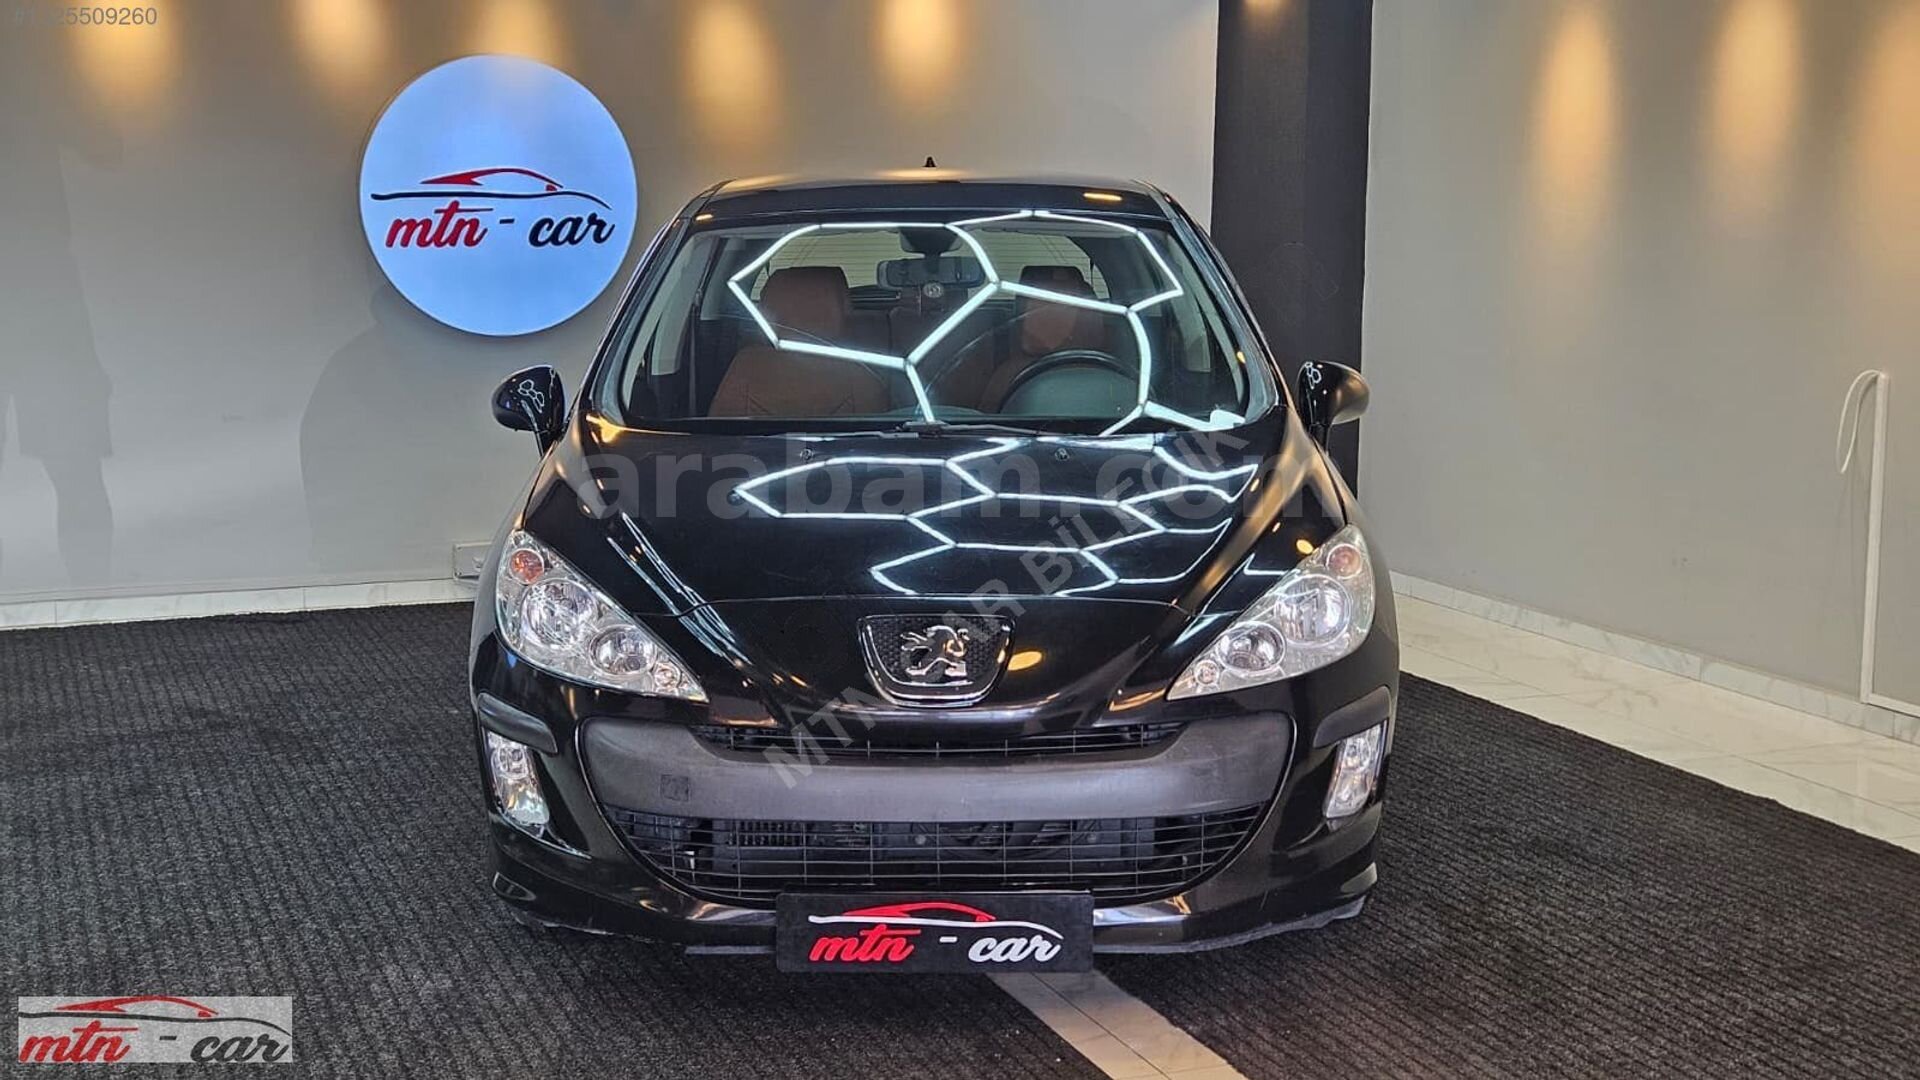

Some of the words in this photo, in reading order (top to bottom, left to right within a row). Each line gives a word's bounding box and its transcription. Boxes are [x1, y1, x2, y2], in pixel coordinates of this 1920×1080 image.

[385, 200, 494, 247] mtn
[529, 213, 615, 247] car
[808, 924, 921, 961] mtn
[968, 935, 1061, 962] car
